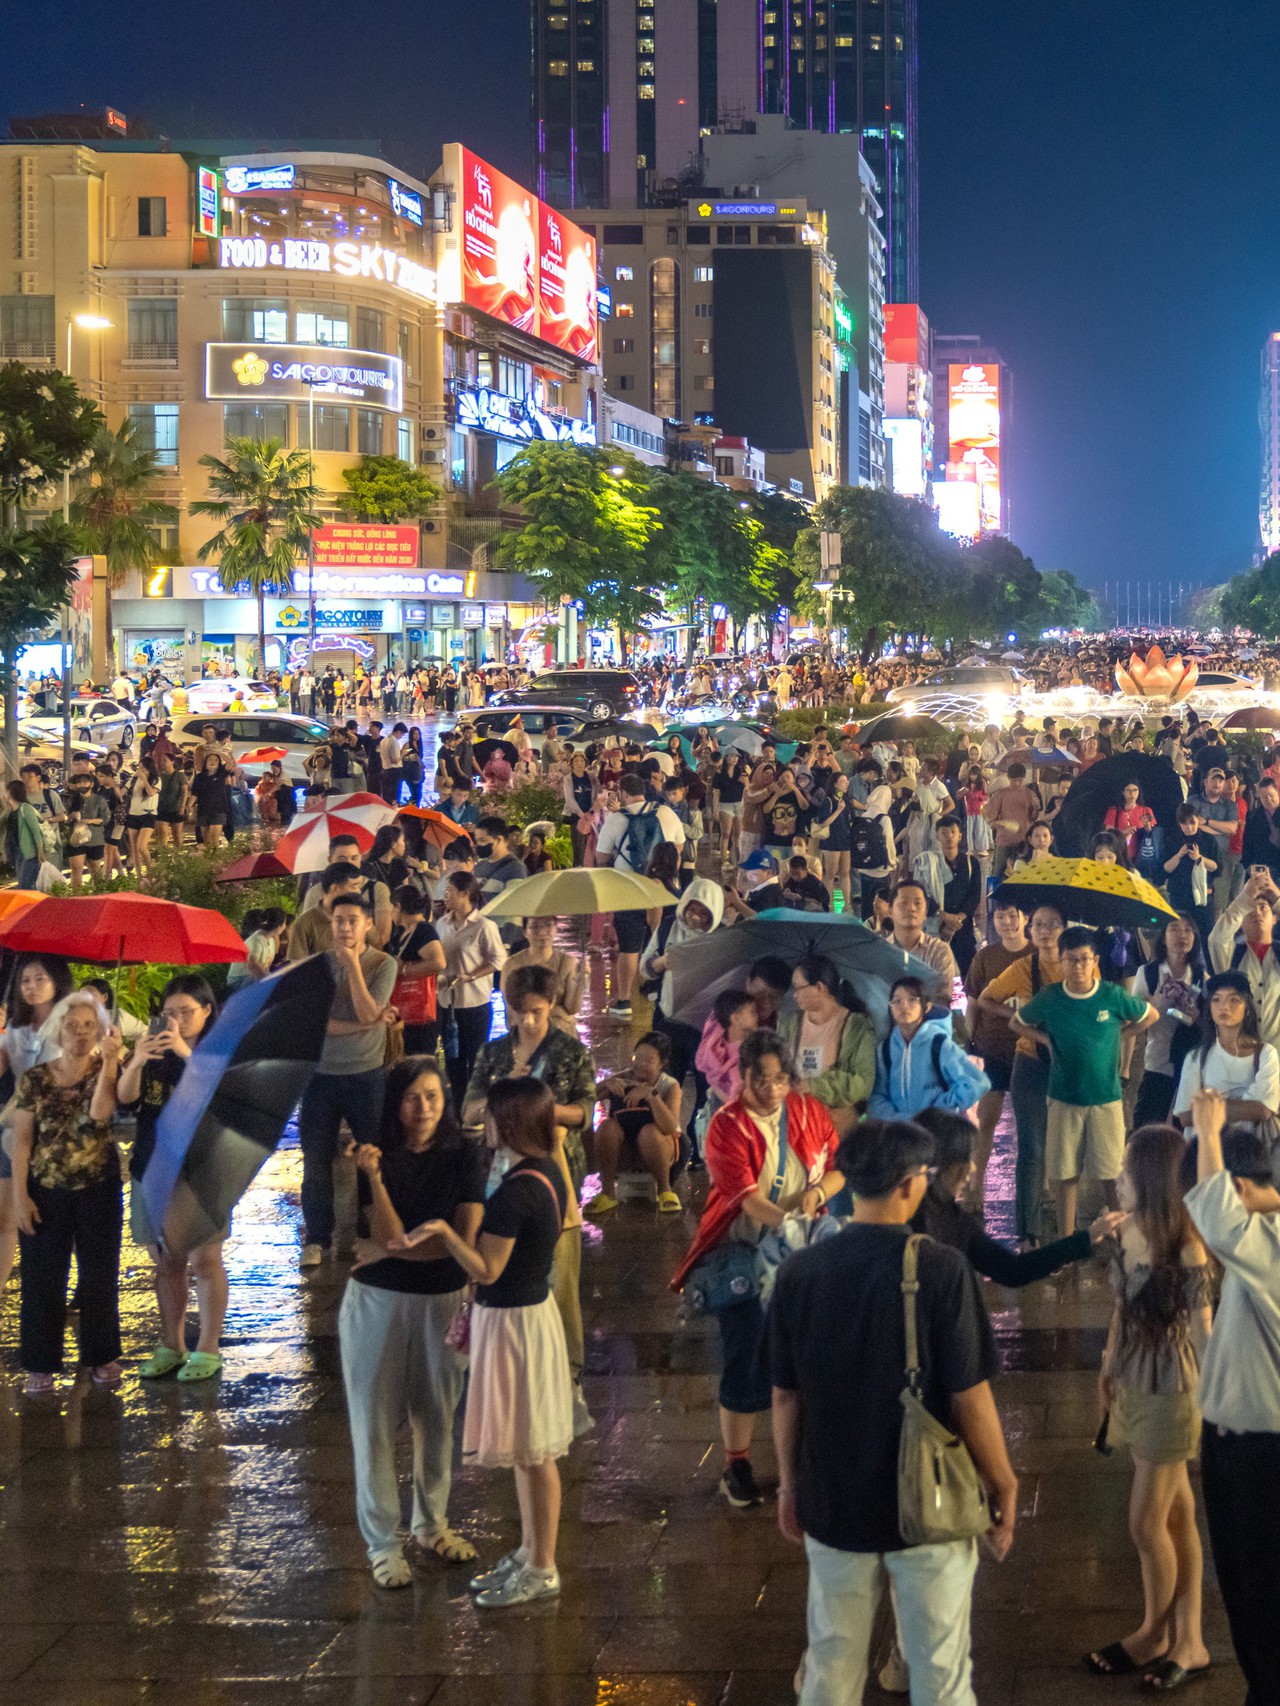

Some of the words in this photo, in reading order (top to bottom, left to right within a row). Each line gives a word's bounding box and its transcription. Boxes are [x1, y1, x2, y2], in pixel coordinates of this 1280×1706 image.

[715, 204, 776, 214] SAIGONTOURIST
[220, 238, 266, 267] FOOD
[283, 239, 331, 271] BEER
[333, 242, 397, 282] SKY
[271, 362, 386, 389] SAIGONTOURIST
[333, 529, 352, 538] CHUNG
[303, 610, 384, 621] SIGONTOURIST
